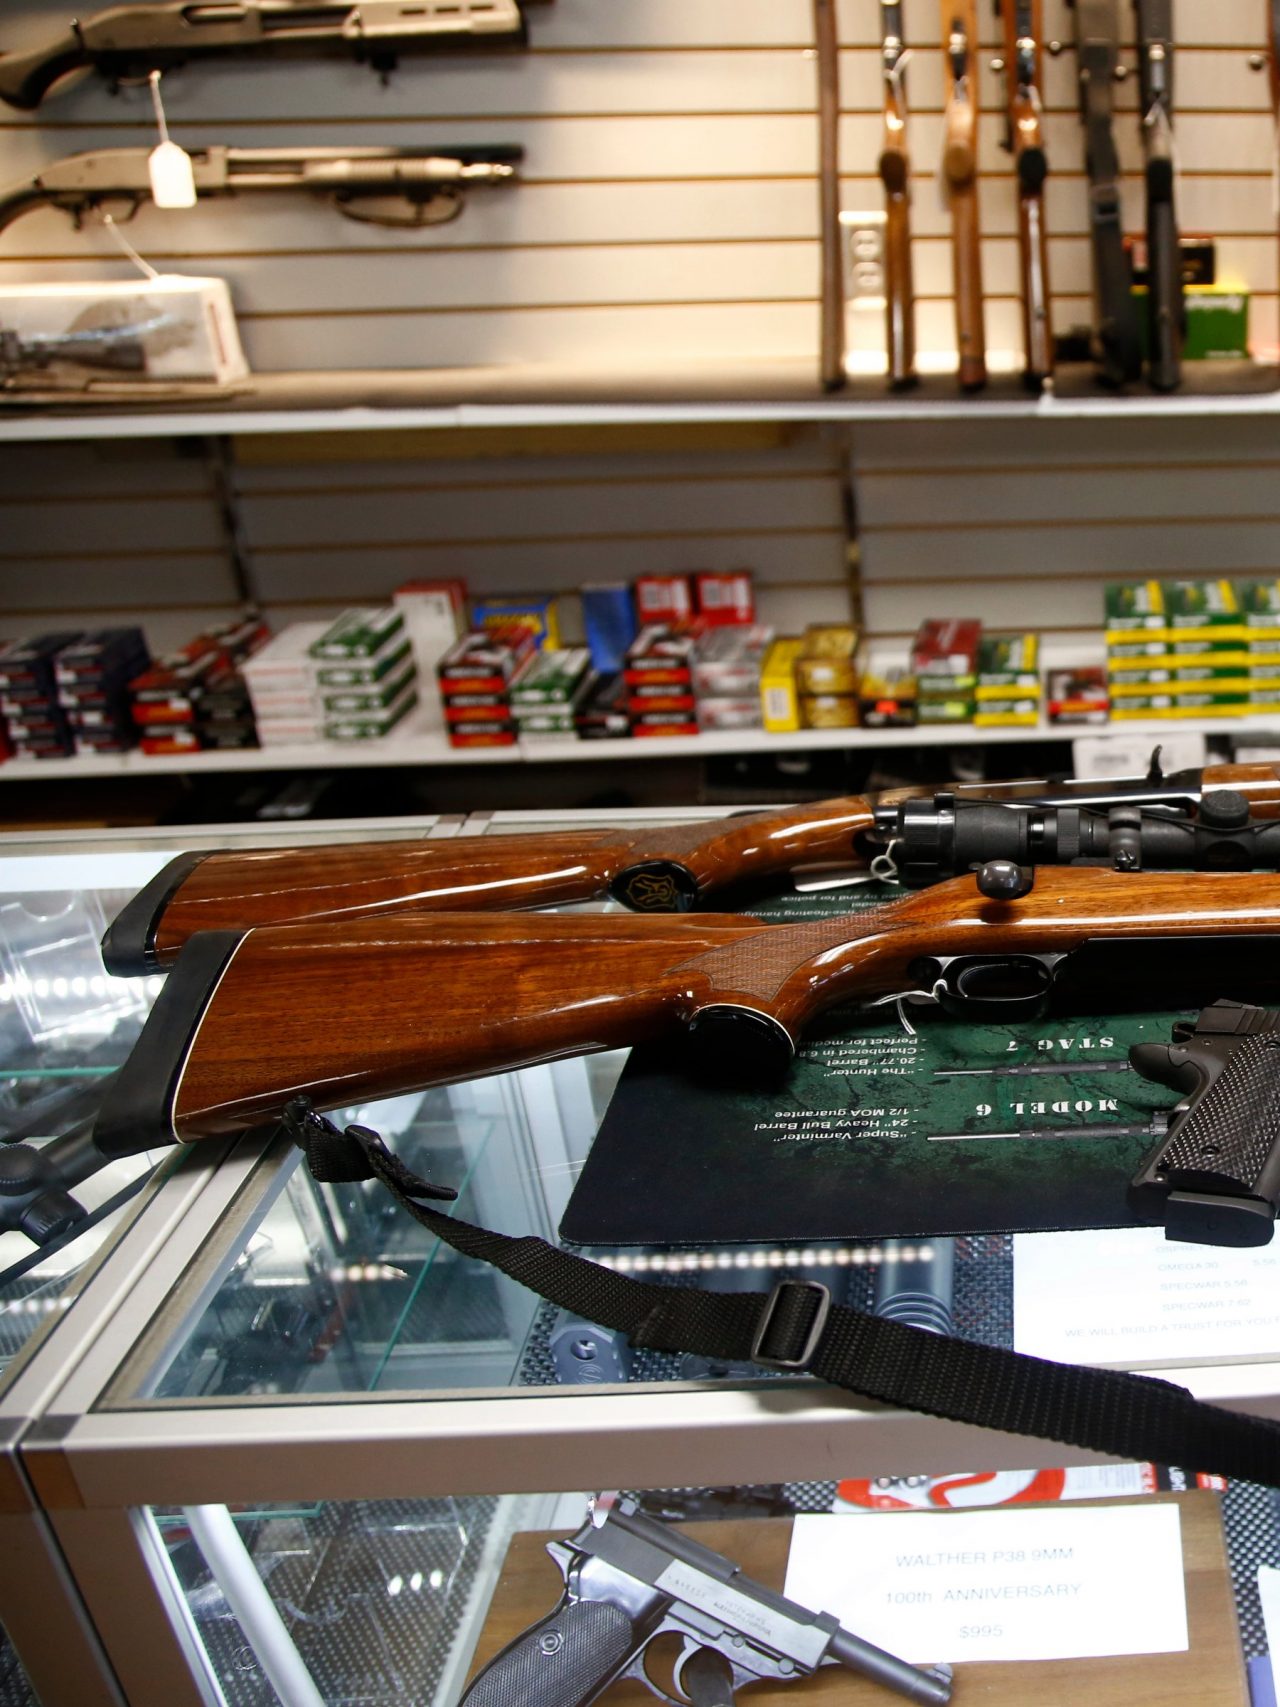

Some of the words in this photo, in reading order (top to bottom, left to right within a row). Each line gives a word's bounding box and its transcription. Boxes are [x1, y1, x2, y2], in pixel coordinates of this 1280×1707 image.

[1006, 1040, 1018, 1051] 7
[1038, 1037, 1114, 1050] STAG
[840, 1047, 917, 1056] Chambered
[826, 1058, 868, 1066] Barrel
[889, 1108, 910, 1116] 1/2
[976, 1104, 992, 1116] 6
[1010, 1098, 1118, 1115] MODEL
[774, 1108, 847, 1118] guarantee
[850, 1108, 884, 1117] MOA
[754, 1122, 797, 1131] Barrel
[801, 1121, 831, 1129] Bull
[836, 1120, 880, 1128] Heavy
[1158, 1263, 1202, 1272] OMEGA
[1160, 1281, 1222, 1292] SPECWAR
[1162, 1300, 1224, 1312] SPECWAR
[1064, 1329, 1085, 1337] WE
[1089, 1328, 1118, 1336] WILL
[1121, 1326, 1158, 1335] BUILD
[1160, 1324, 1168, 1332] A
[1172, 1322, 1212, 1331] TRUST
[1216, 1320, 1242, 1329] FOR
[1246, 1316, 1272, 1326] YOU
[896, 1551, 986, 1568] WALTHER
[992, 1550, 1026, 1564] P38
[1031, 1547, 1074, 1561] 9MM
[886, 1590, 933, 1605] 100th
[944, 1582, 1082, 1602] ANNIVERSARY
[959, 1624, 1004, 1640] $995
